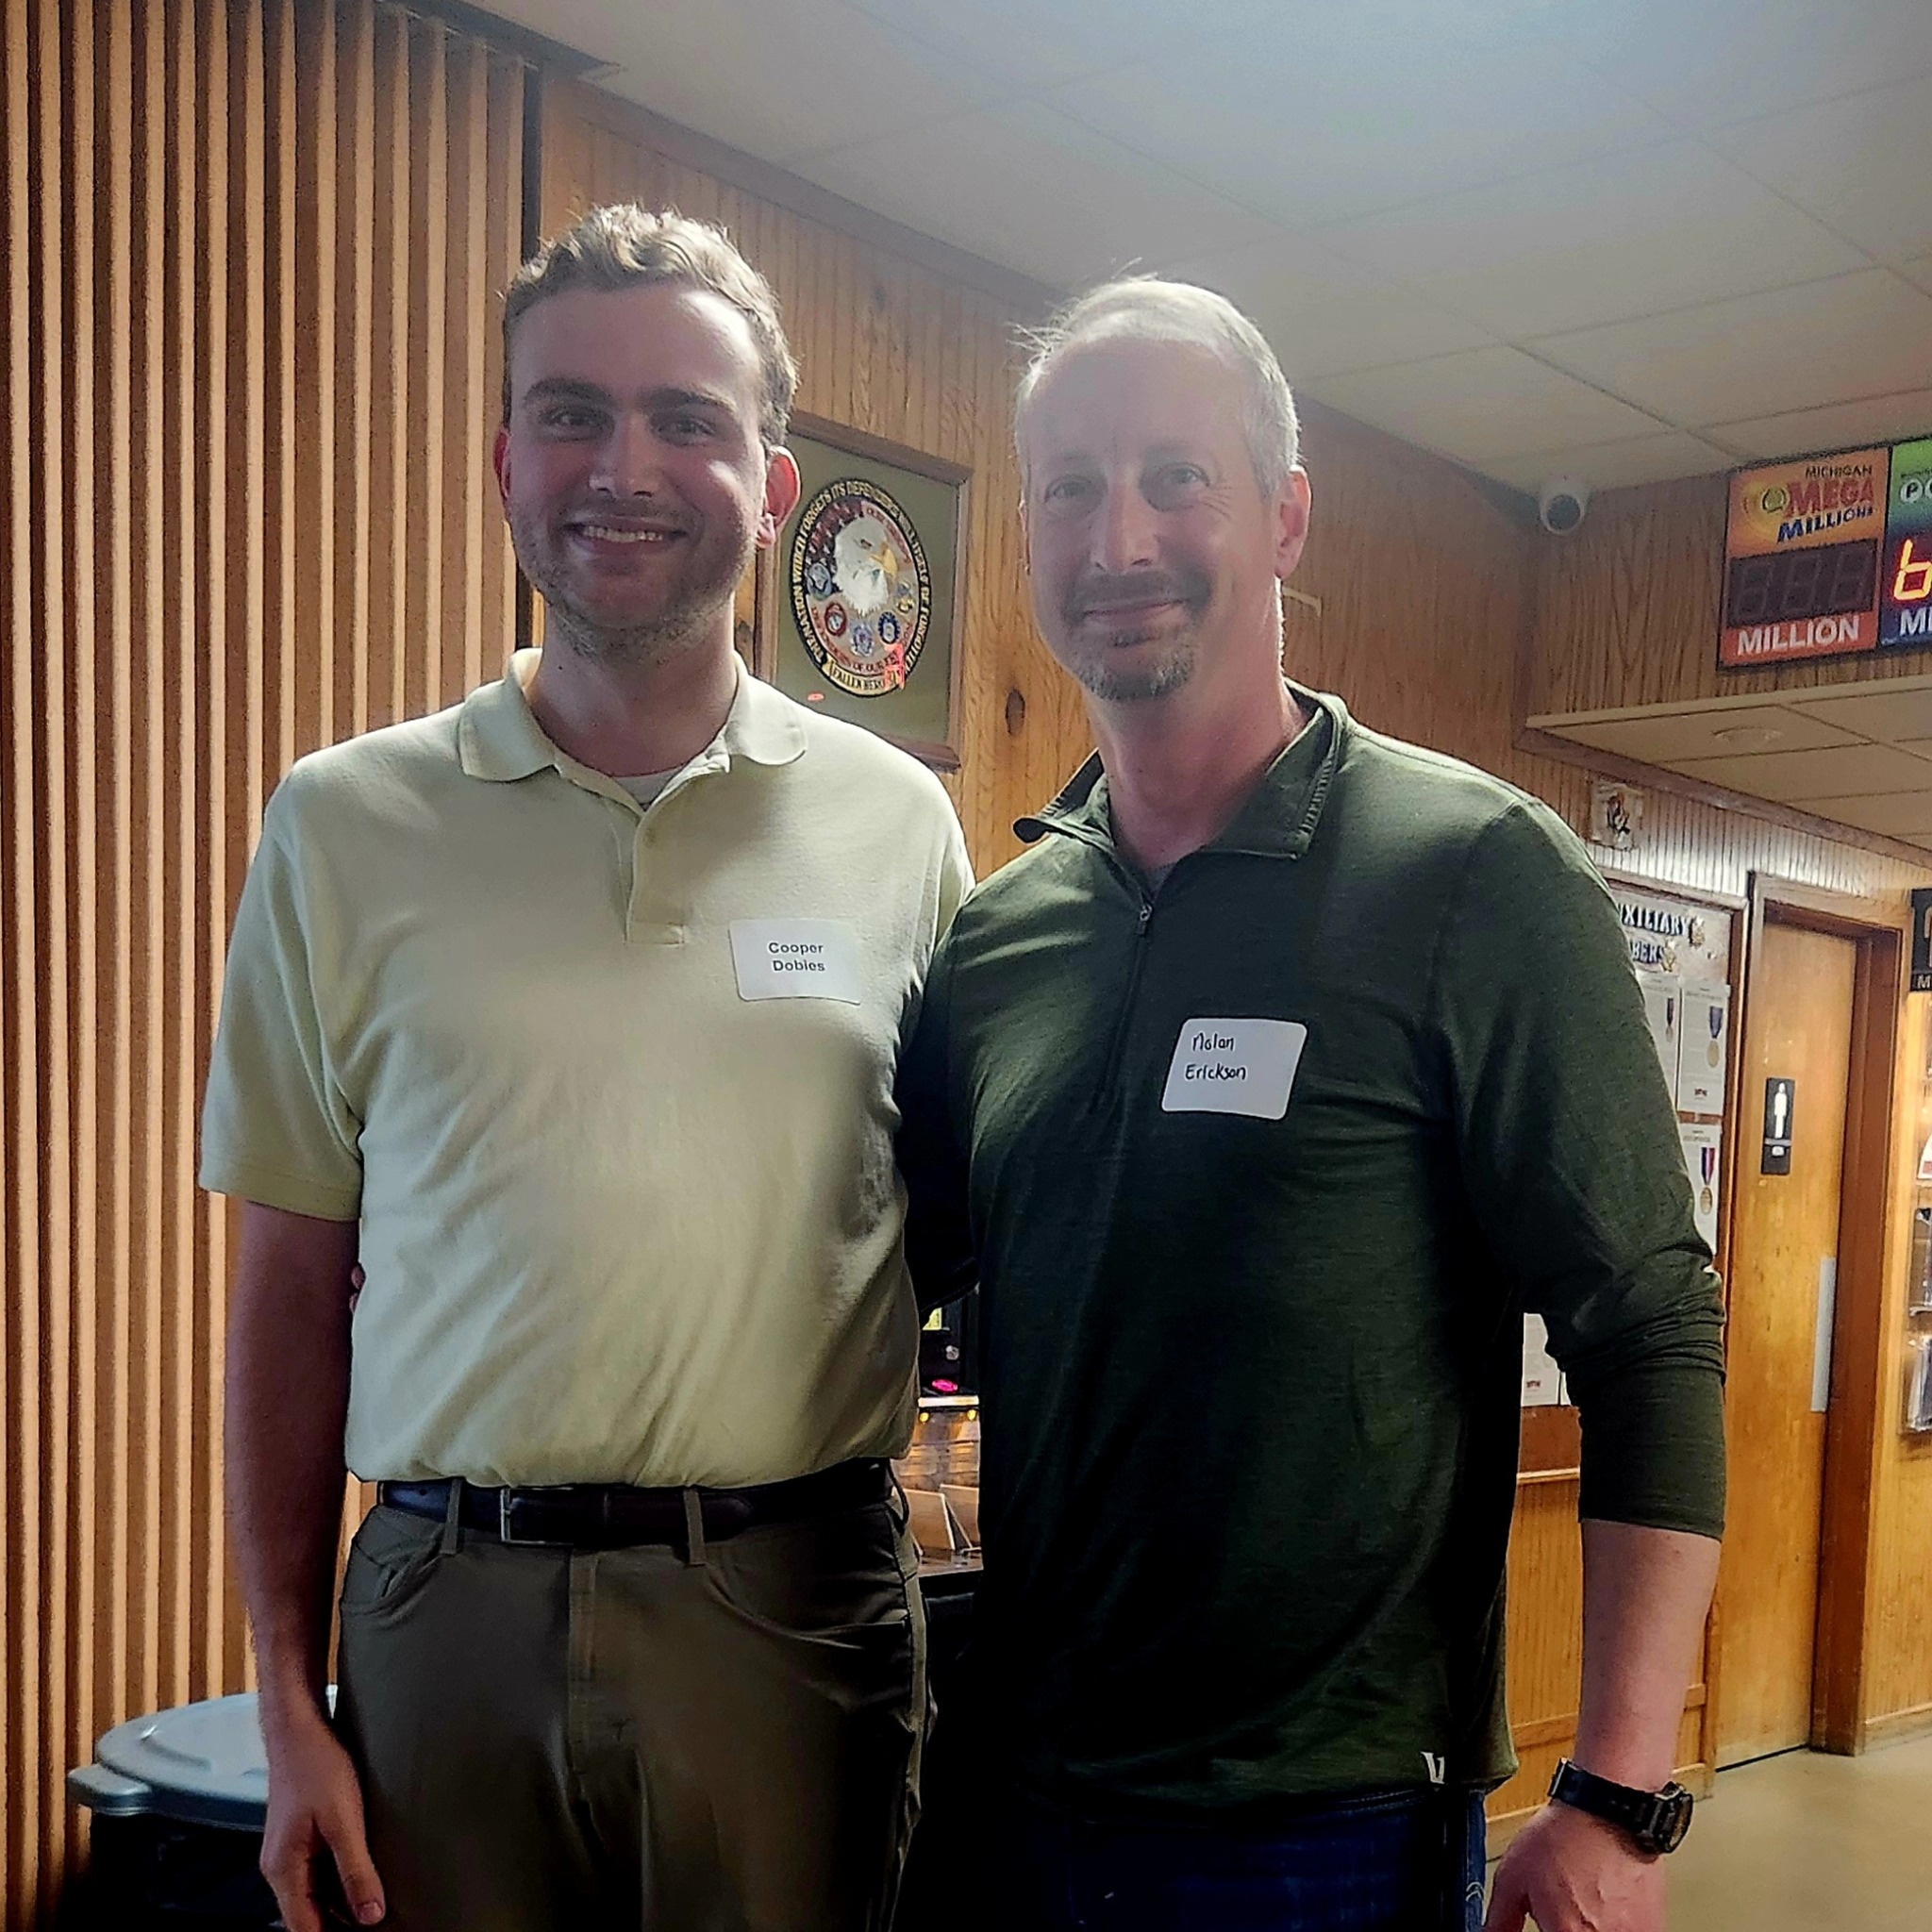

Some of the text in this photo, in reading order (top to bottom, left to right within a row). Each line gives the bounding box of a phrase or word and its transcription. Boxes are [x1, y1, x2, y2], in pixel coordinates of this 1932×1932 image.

[1806, 465, 1873, 478] MICHIGAN
[1785, 477, 1874, 518] MEGA
[1738, 615, 1859, 656] MILLION
[768, 941, 824, 955] Cooper
[1185, 1062, 1246, 1080] Erickson
